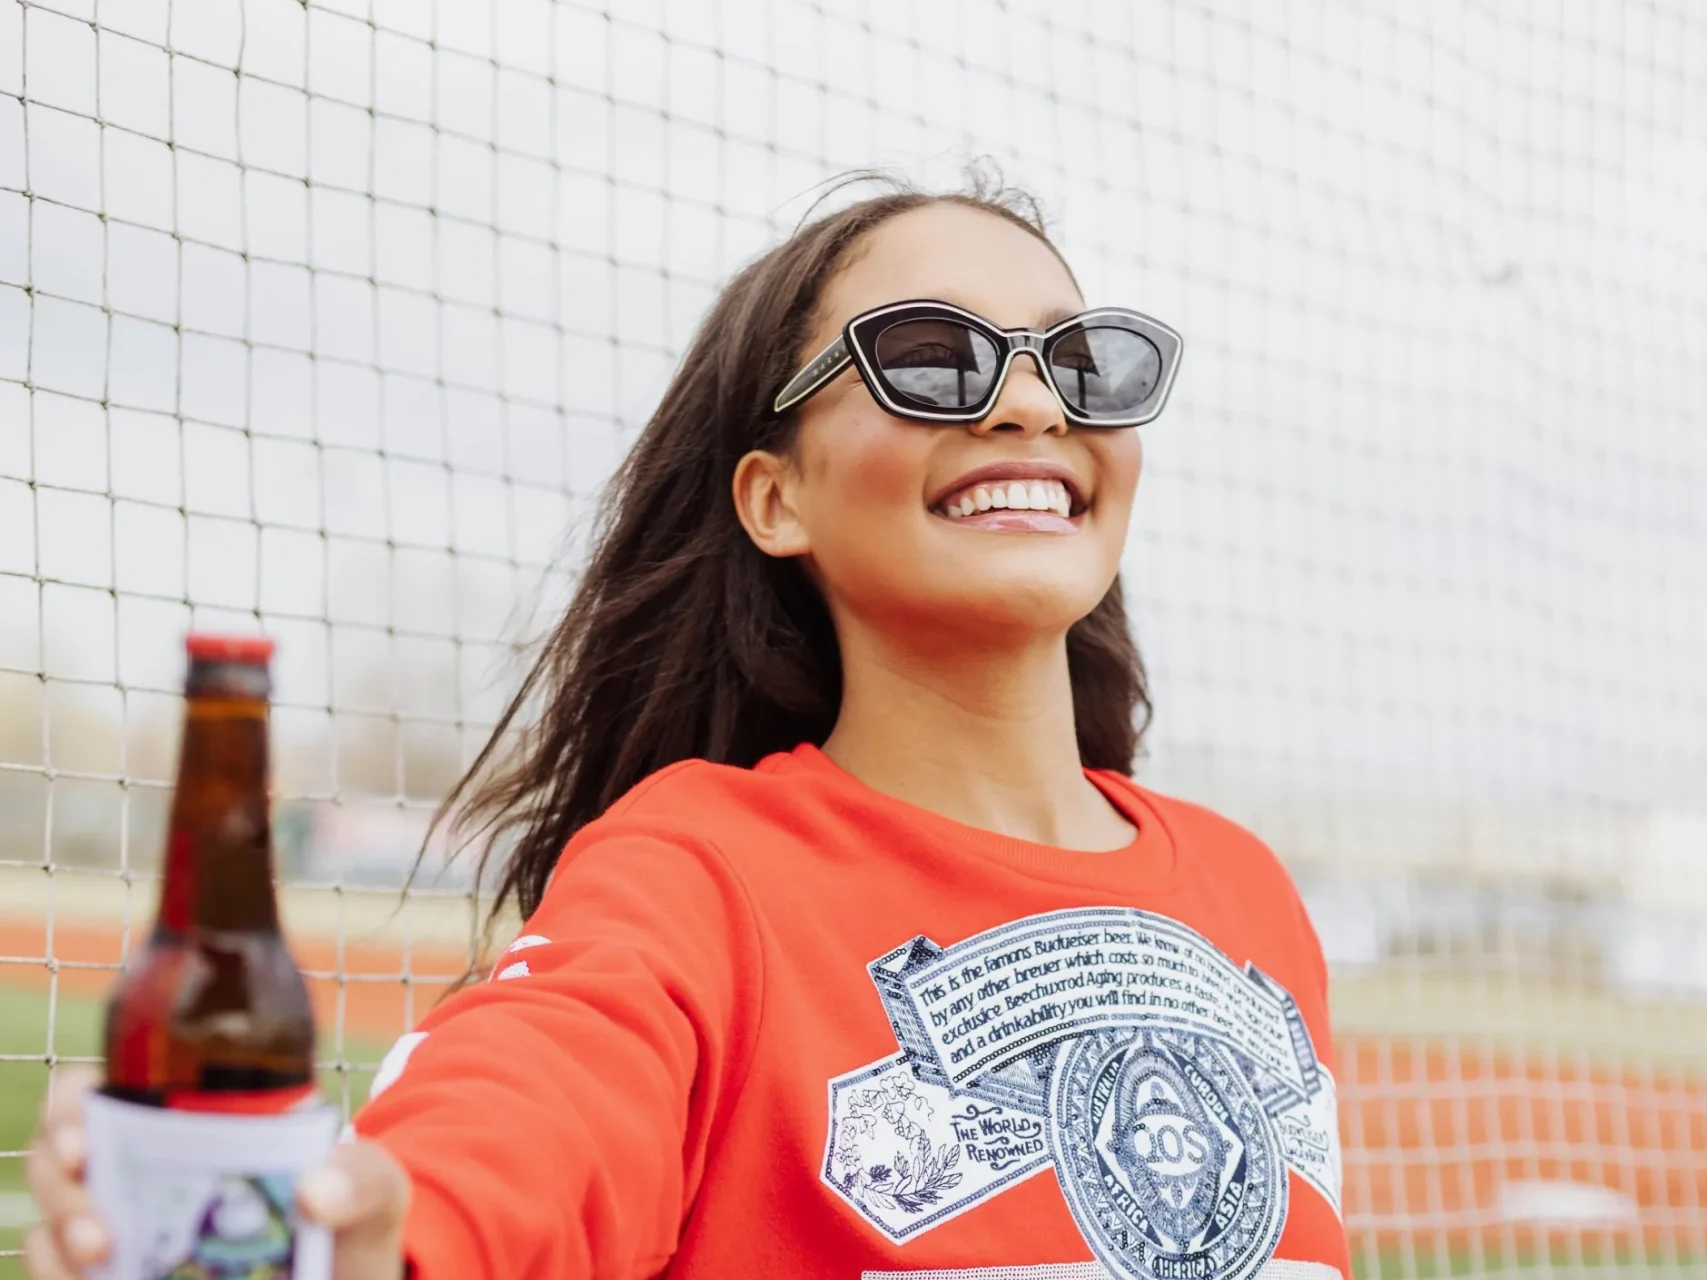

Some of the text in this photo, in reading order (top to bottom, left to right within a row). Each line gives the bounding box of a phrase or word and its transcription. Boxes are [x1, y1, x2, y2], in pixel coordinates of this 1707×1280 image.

[919, 984, 946, 1007] This
[949, 975, 960, 992] is
[962, 964, 984, 984] the
[930, 1007, 948, 1028] by
[950, 992, 974, 1012] any
[977, 976, 1011, 1000] other
[1065, 949, 1104, 969] which
[1109, 951, 1138, 965] costs
[1142, 954, 1154, 965] so
[1086, 968, 1123, 988] Aging
[1126, 971, 1182, 990] produces
[950, 1039, 975, 1064] and
[976, 1035, 987, 1049] a
[1067, 996, 1092, 1015] you
[1095, 990, 1119, 1006] will
[1122, 990, 1146, 1005] find
[1149, 991, 1161, 1006] in
[1163, 997, 1179, 1009] no
[949, 1117, 1041, 1142] THE WORLD
[966, 1139, 1044, 1162] RENOWNED
[1103, 1174, 1148, 1233] AFRICA
[1215, 1182, 1244, 1230] ASIA
